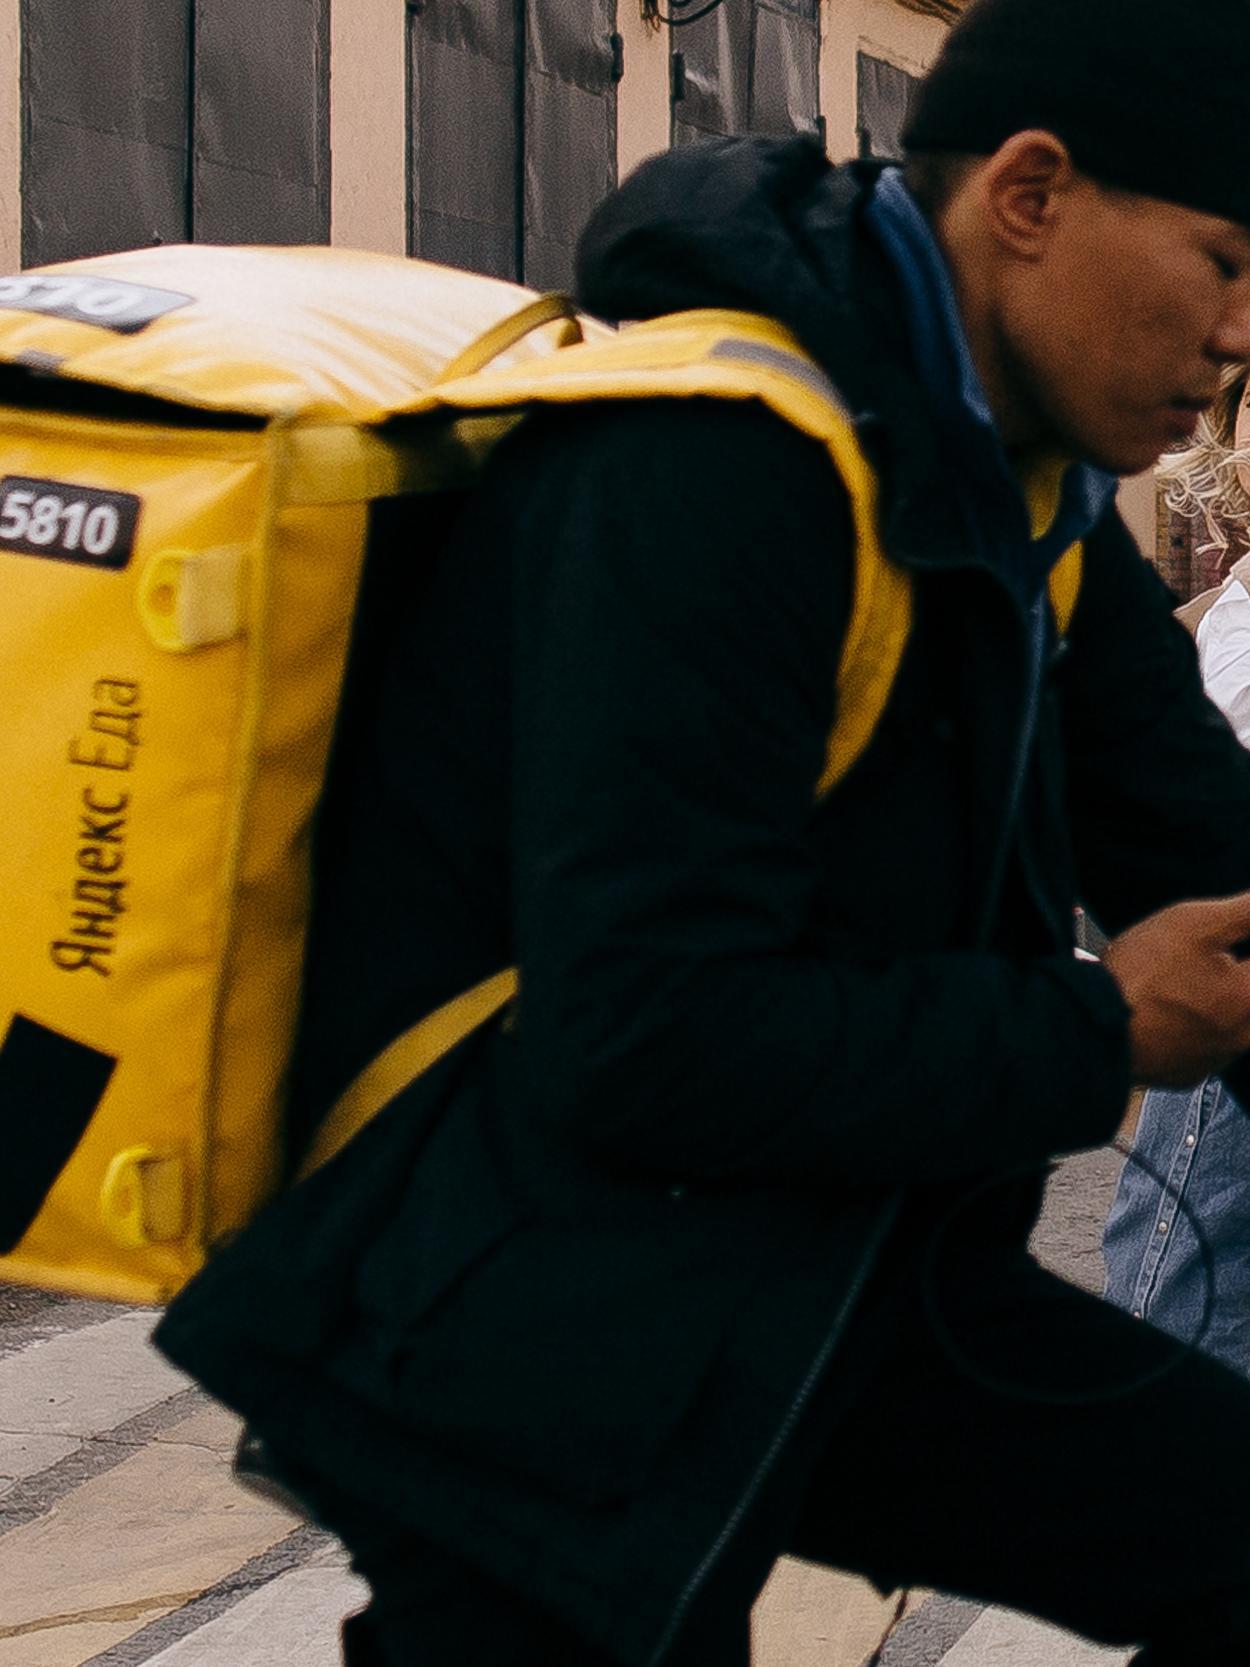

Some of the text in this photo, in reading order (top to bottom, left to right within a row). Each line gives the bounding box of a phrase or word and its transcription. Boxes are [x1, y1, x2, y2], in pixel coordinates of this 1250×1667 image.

[0, 488, 121, 556] 5810
[50, 674, 143, 978] Яндекс Еда
